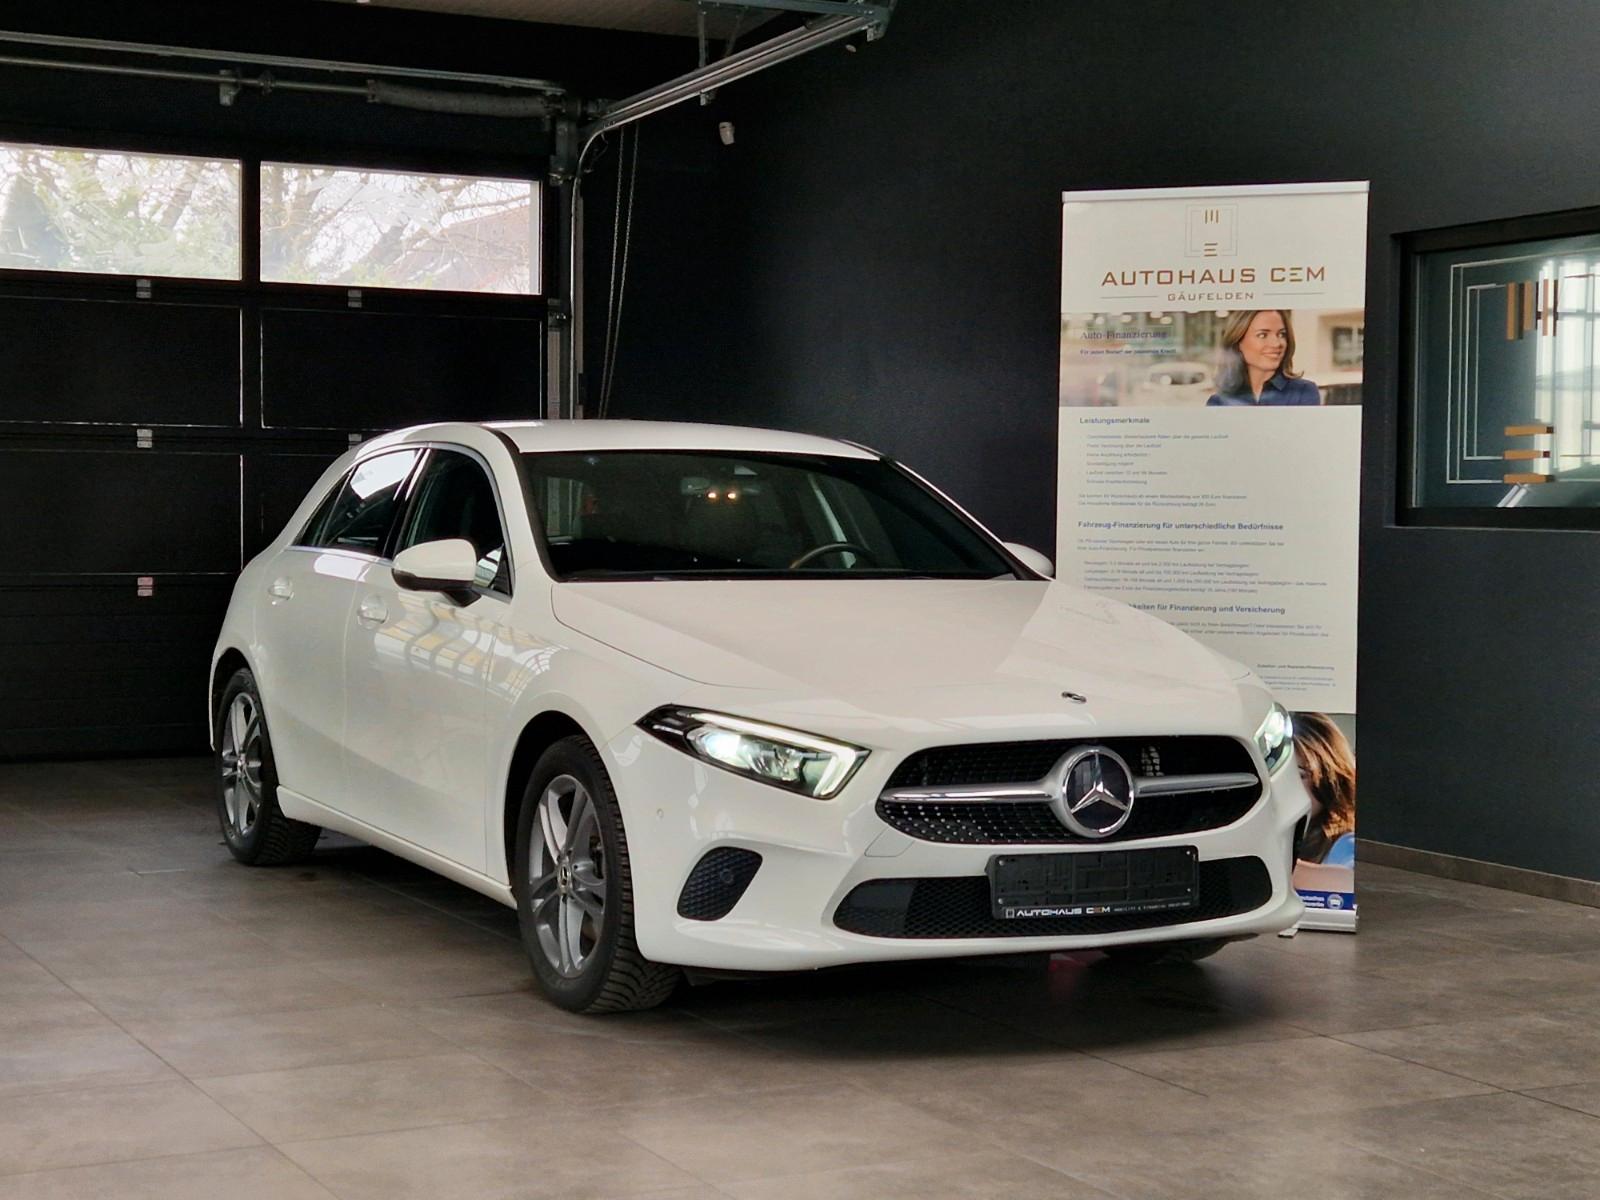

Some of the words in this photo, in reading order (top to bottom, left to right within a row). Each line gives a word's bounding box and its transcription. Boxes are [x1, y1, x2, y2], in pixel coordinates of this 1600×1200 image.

[1101, 267, 1256, 287] AUTOHAUS
[1270, 265, 1326, 283] CEM
[1167, 291, 1255, 302] GÄUFELDEN
[1080, 330, 1169, 341] Auto-Finanzierung
[1079, 417, 1151, 426] Leistungsmerkmale
[1078, 521, 1161, 530] Fahrzeug-Finanzierung
[1174, 522, 1236, 530] unterschiedliche
[1237, 522, 1284, 531] Bedürfnisse
[1157, 604, 1168, 612] für
[1169, 604, 1217, 614] Finanzierung
[1218, 605, 1234, 613] und
[1235, 605, 1286, 615] Versicherung
[1016, 907, 1083, 917] AUTOHAUS
